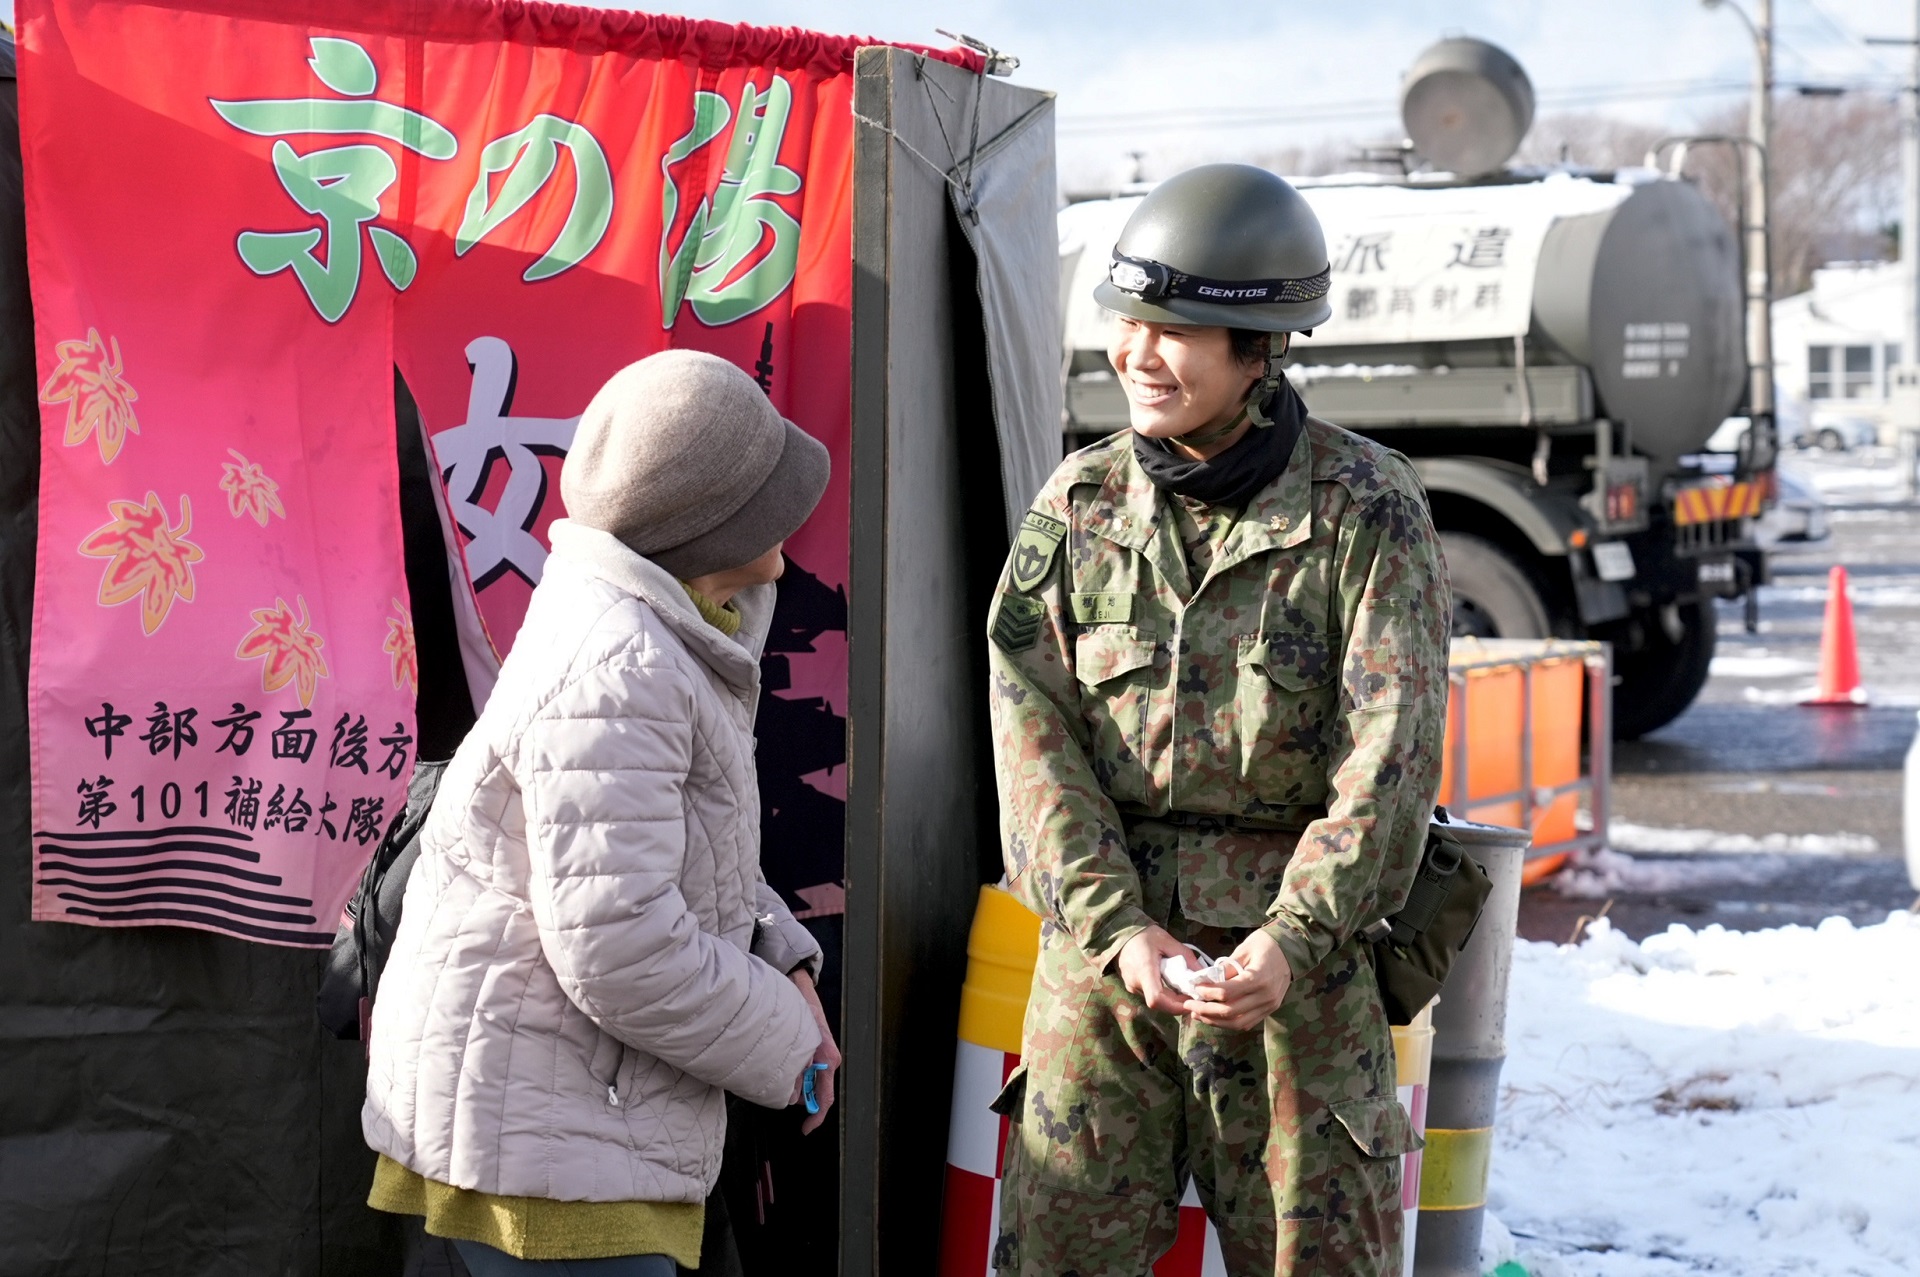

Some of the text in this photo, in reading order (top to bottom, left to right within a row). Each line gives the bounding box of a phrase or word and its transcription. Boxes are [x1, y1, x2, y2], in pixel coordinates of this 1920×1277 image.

[208, 36, 802, 329] 京の湯
[1331, 225, 1511, 274] 派遣
[1198, 286, 1268, 298] GENTOS
[431, 335, 583, 590] 女
[84, 702, 414, 780] 中部方面後方
[76, 775, 385, 846] 第101補給大隊
